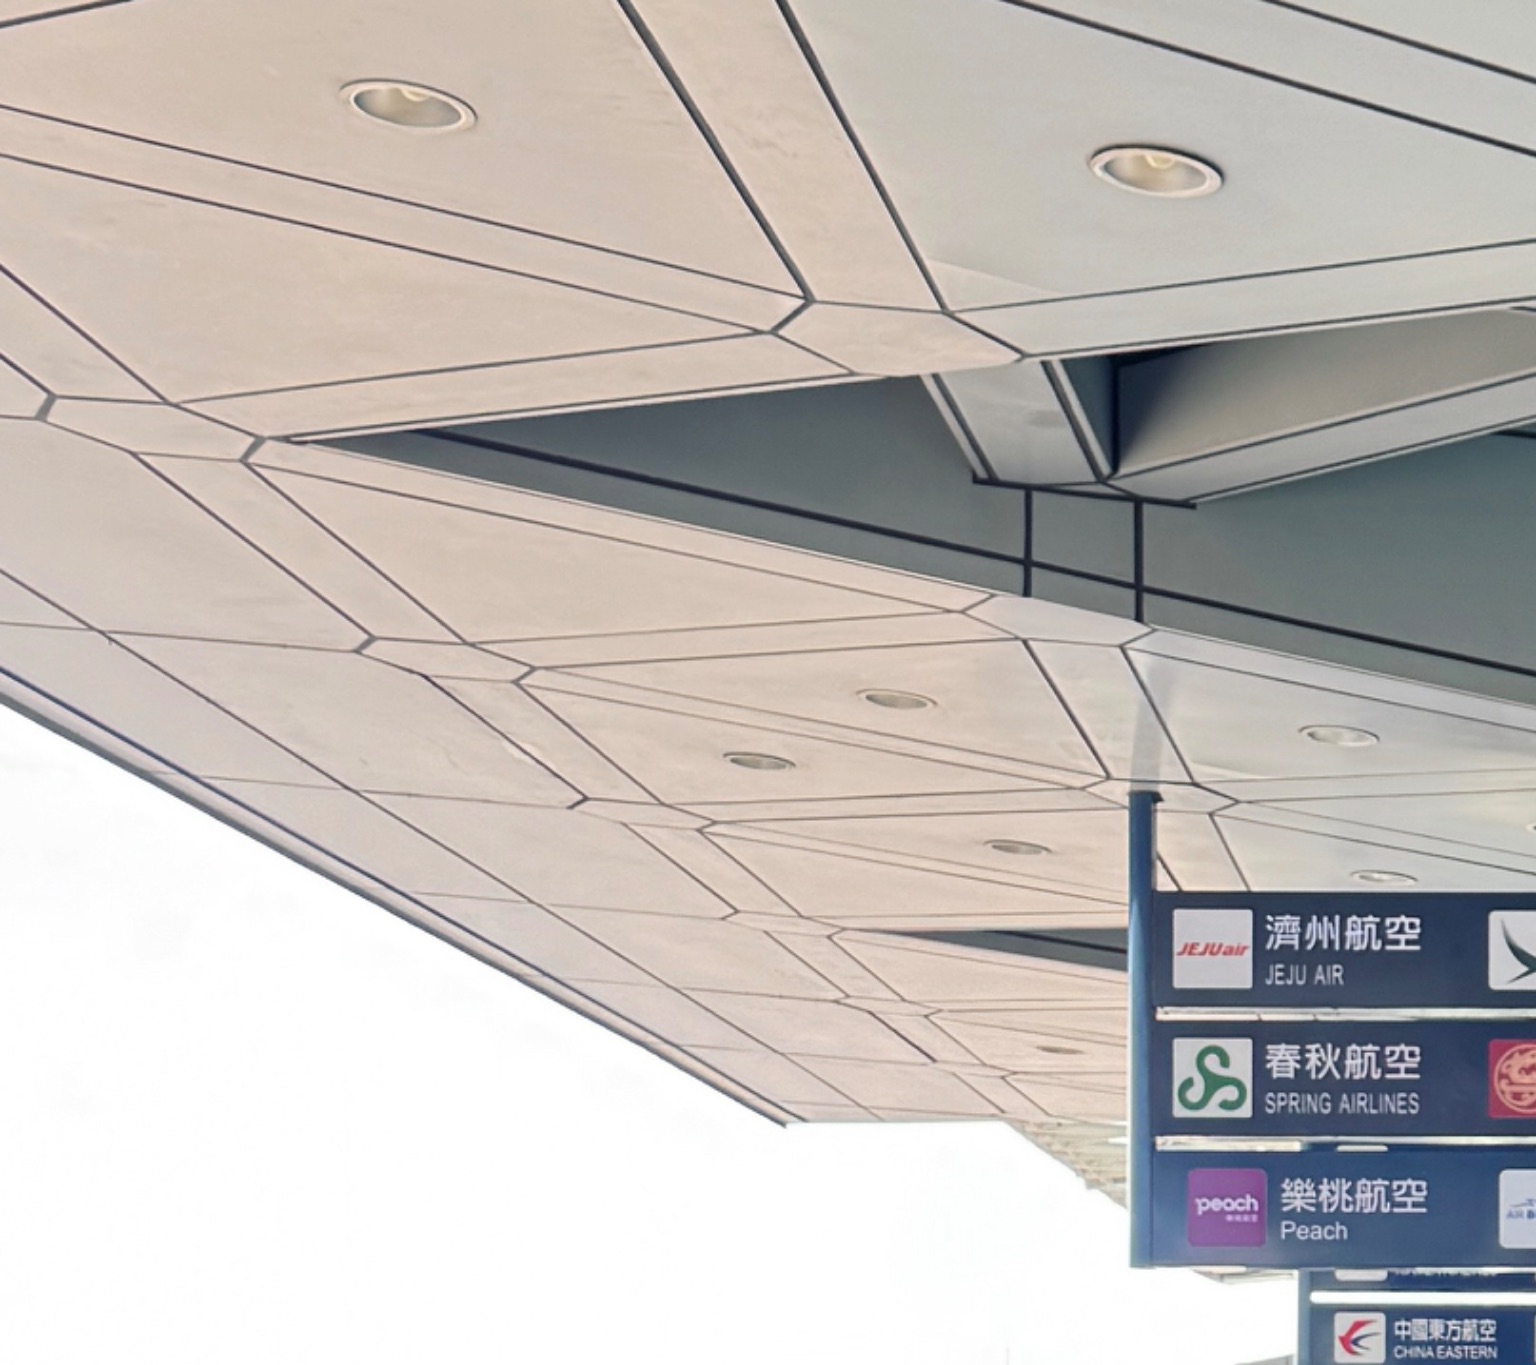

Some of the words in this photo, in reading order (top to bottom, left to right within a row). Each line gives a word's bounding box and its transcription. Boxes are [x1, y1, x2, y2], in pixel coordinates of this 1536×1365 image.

[1265, 914, 1422, 951] 濟州航空
[1265, 964, 1307, 986] JEJU
[1313, 964, 1344, 986] AIR
[1265, 1042, 1421, 1081] 春秋航空
[1265, 1092, 1332, 1115] SPRING
[1338, 1092, 1420, 1115] AIRLINES
[1194, 1193, 1259, 1216] peach
[1280, 1178, 1428, 1214] 樂桃航空
[1280, 1221, 1348, 1240] Peach
[1394, 1318, 1497, 1342] 中國東方航空
[1393, 1345, 1434, 1360] CHINA
[1436, 1345, 1497, 1360] EASTERN
